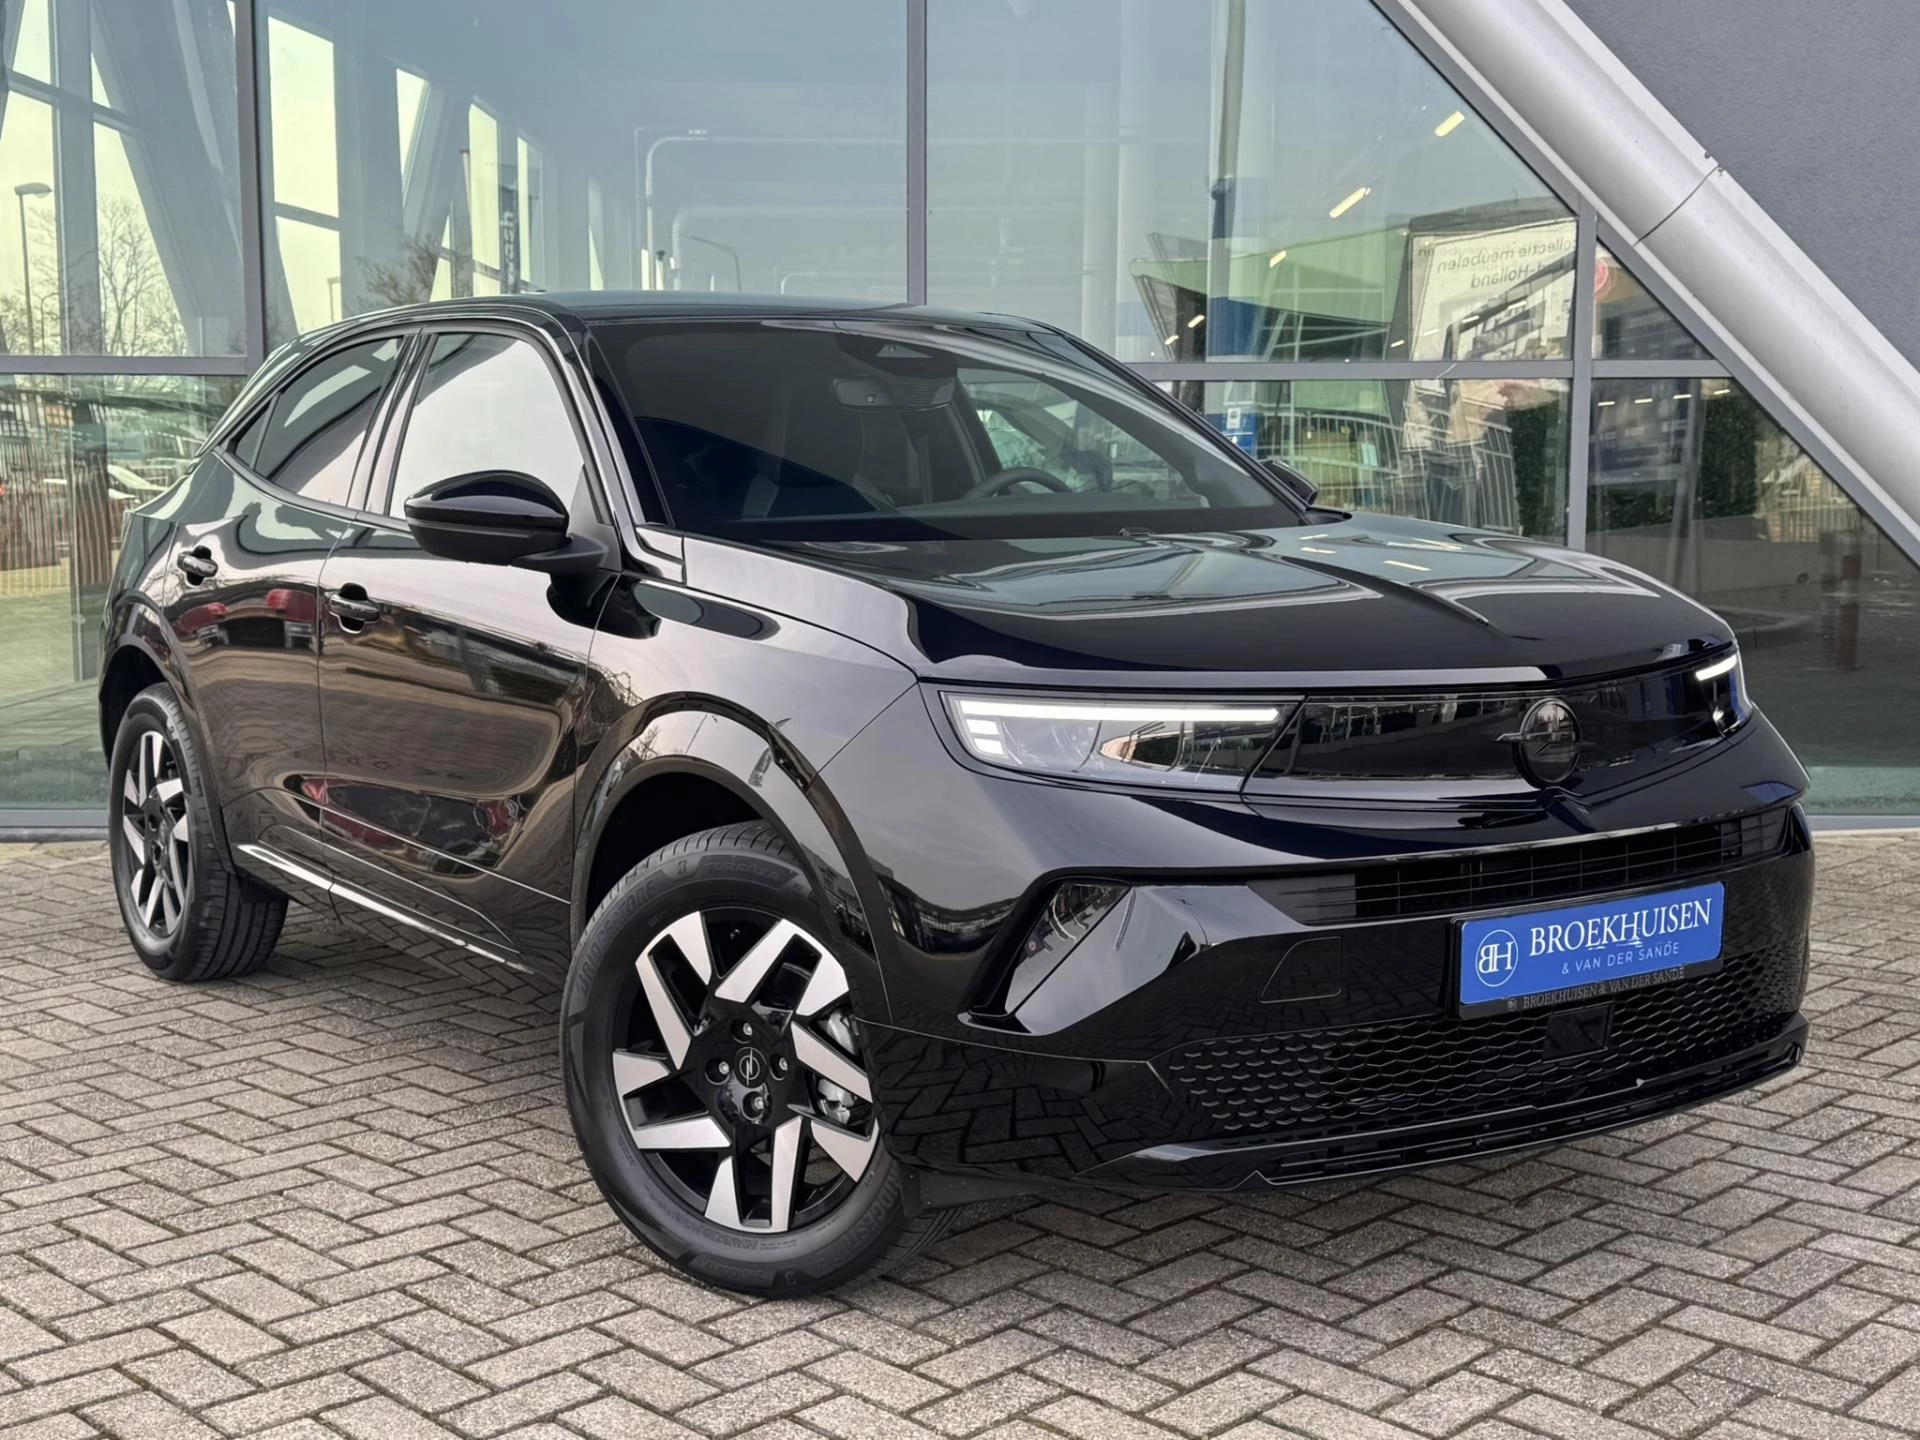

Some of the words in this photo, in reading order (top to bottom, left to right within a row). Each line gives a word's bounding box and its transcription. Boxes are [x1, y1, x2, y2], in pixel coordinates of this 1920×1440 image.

[1529, 898, 1713, 957] BROEKHUISEN
[1562, 963, 1569, 975] &
[1575, 957, 1600, 973] VAN
[1607, 951, 1633, 967] DER
[1523, 983, 1600, 1009] BROEKHUISEN
[1608, 978, 1630, 993] VAN
[1631, 974, 1651, 989] DER
